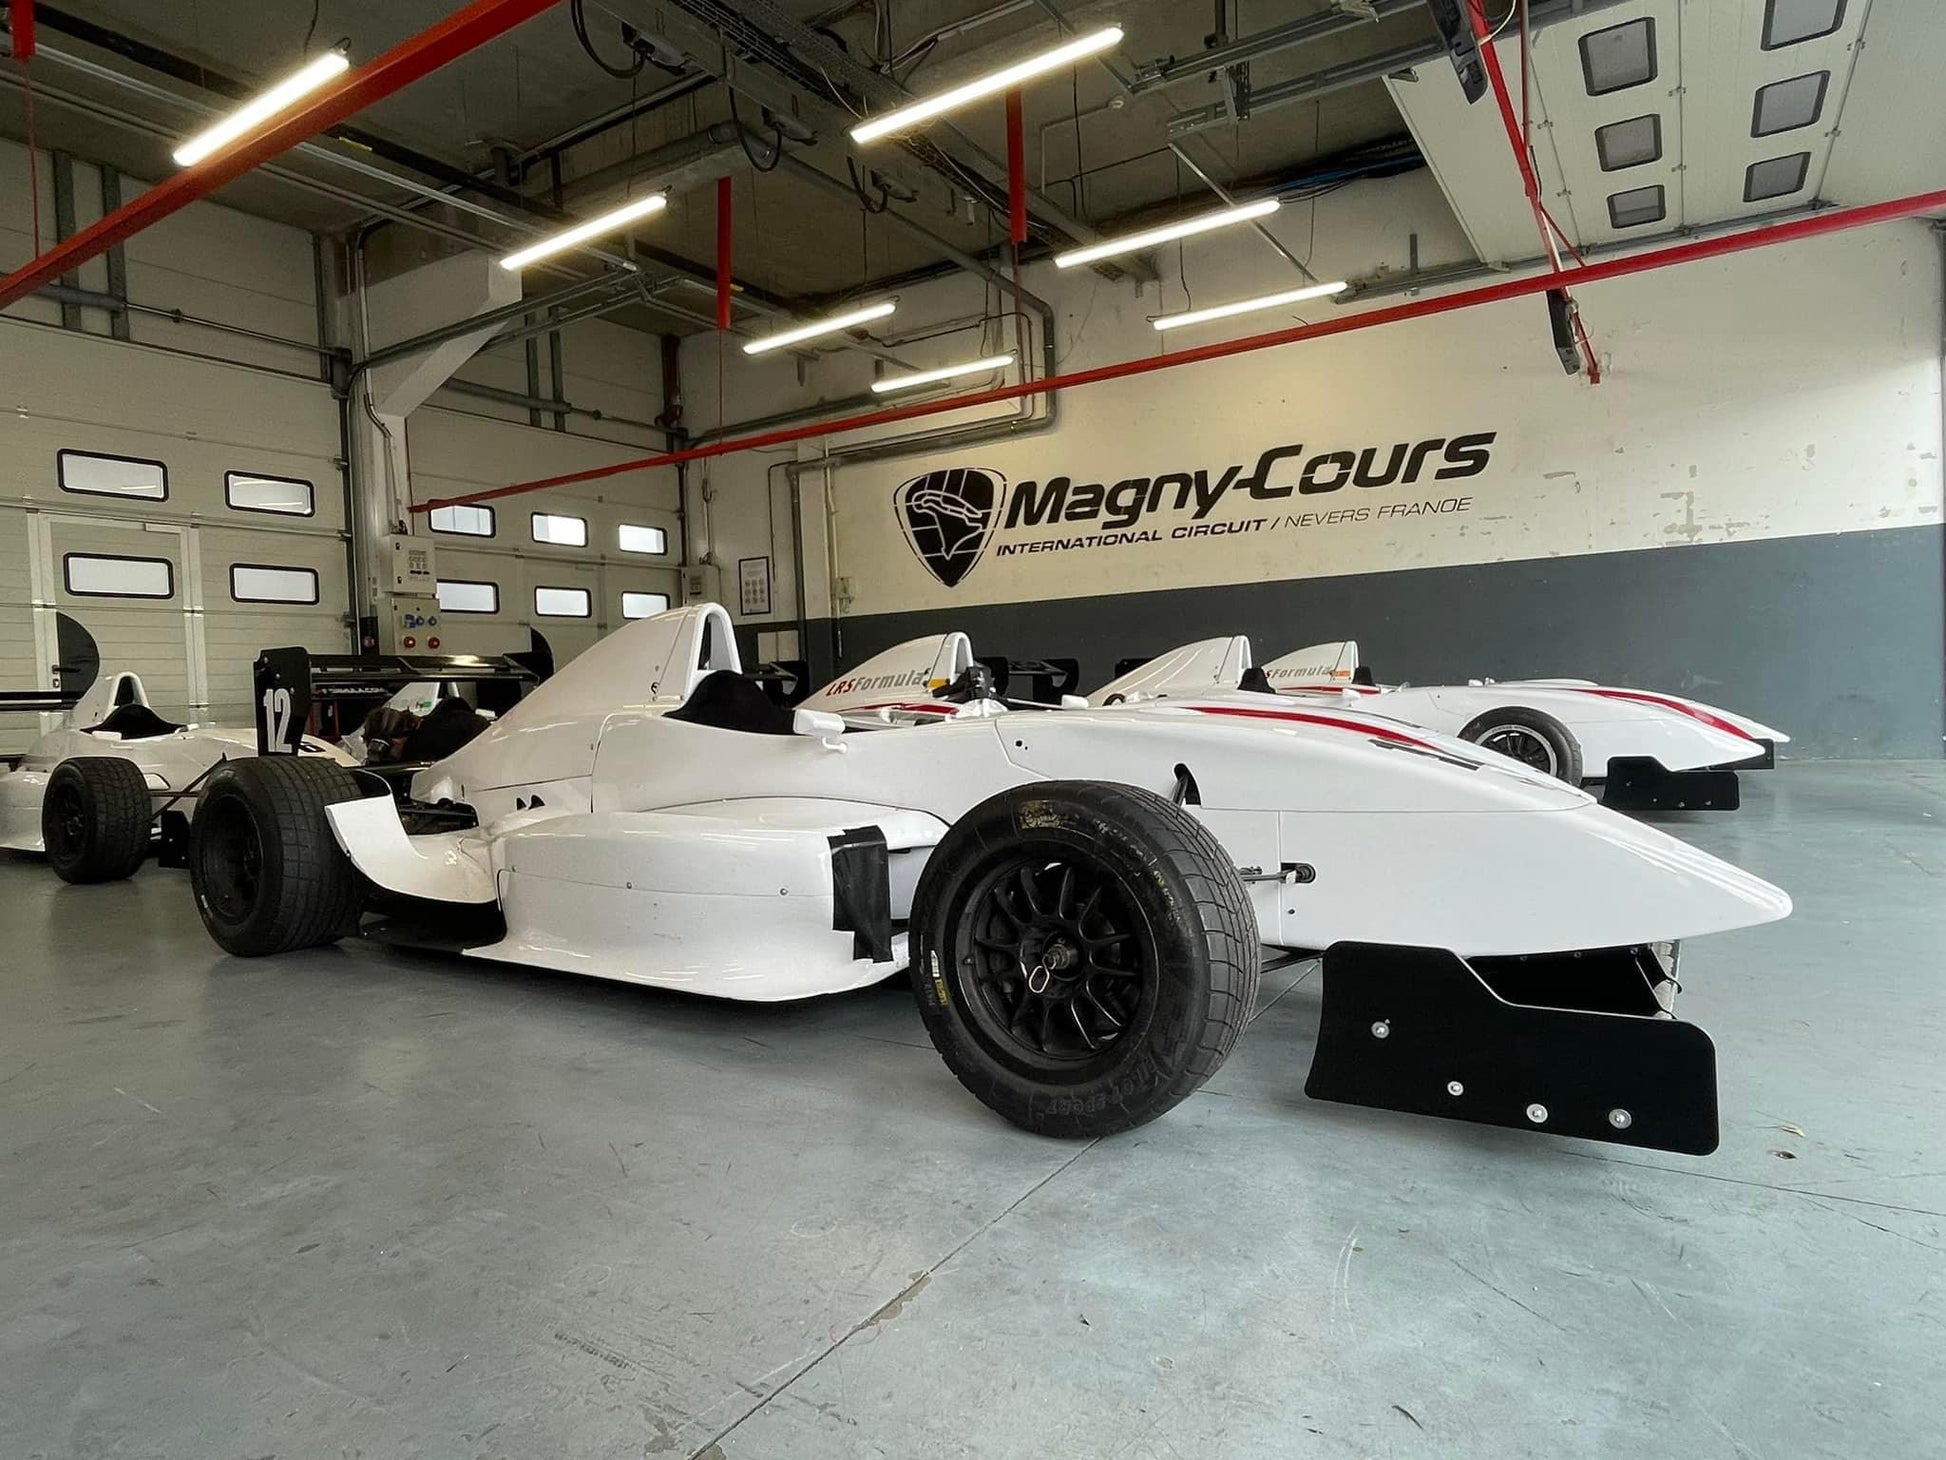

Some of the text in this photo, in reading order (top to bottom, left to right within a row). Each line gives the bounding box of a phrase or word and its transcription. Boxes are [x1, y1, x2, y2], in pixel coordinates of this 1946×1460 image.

[1004, 432, 1497, 530] Magny-Cours
[996, 530, 1163, 557] INTERNATIONAL
[1171, 518, 1268, 540] CIRCUIT
[1284, 507, 1371, 528] NEVERS
[263, 688, 293, 753] 12
